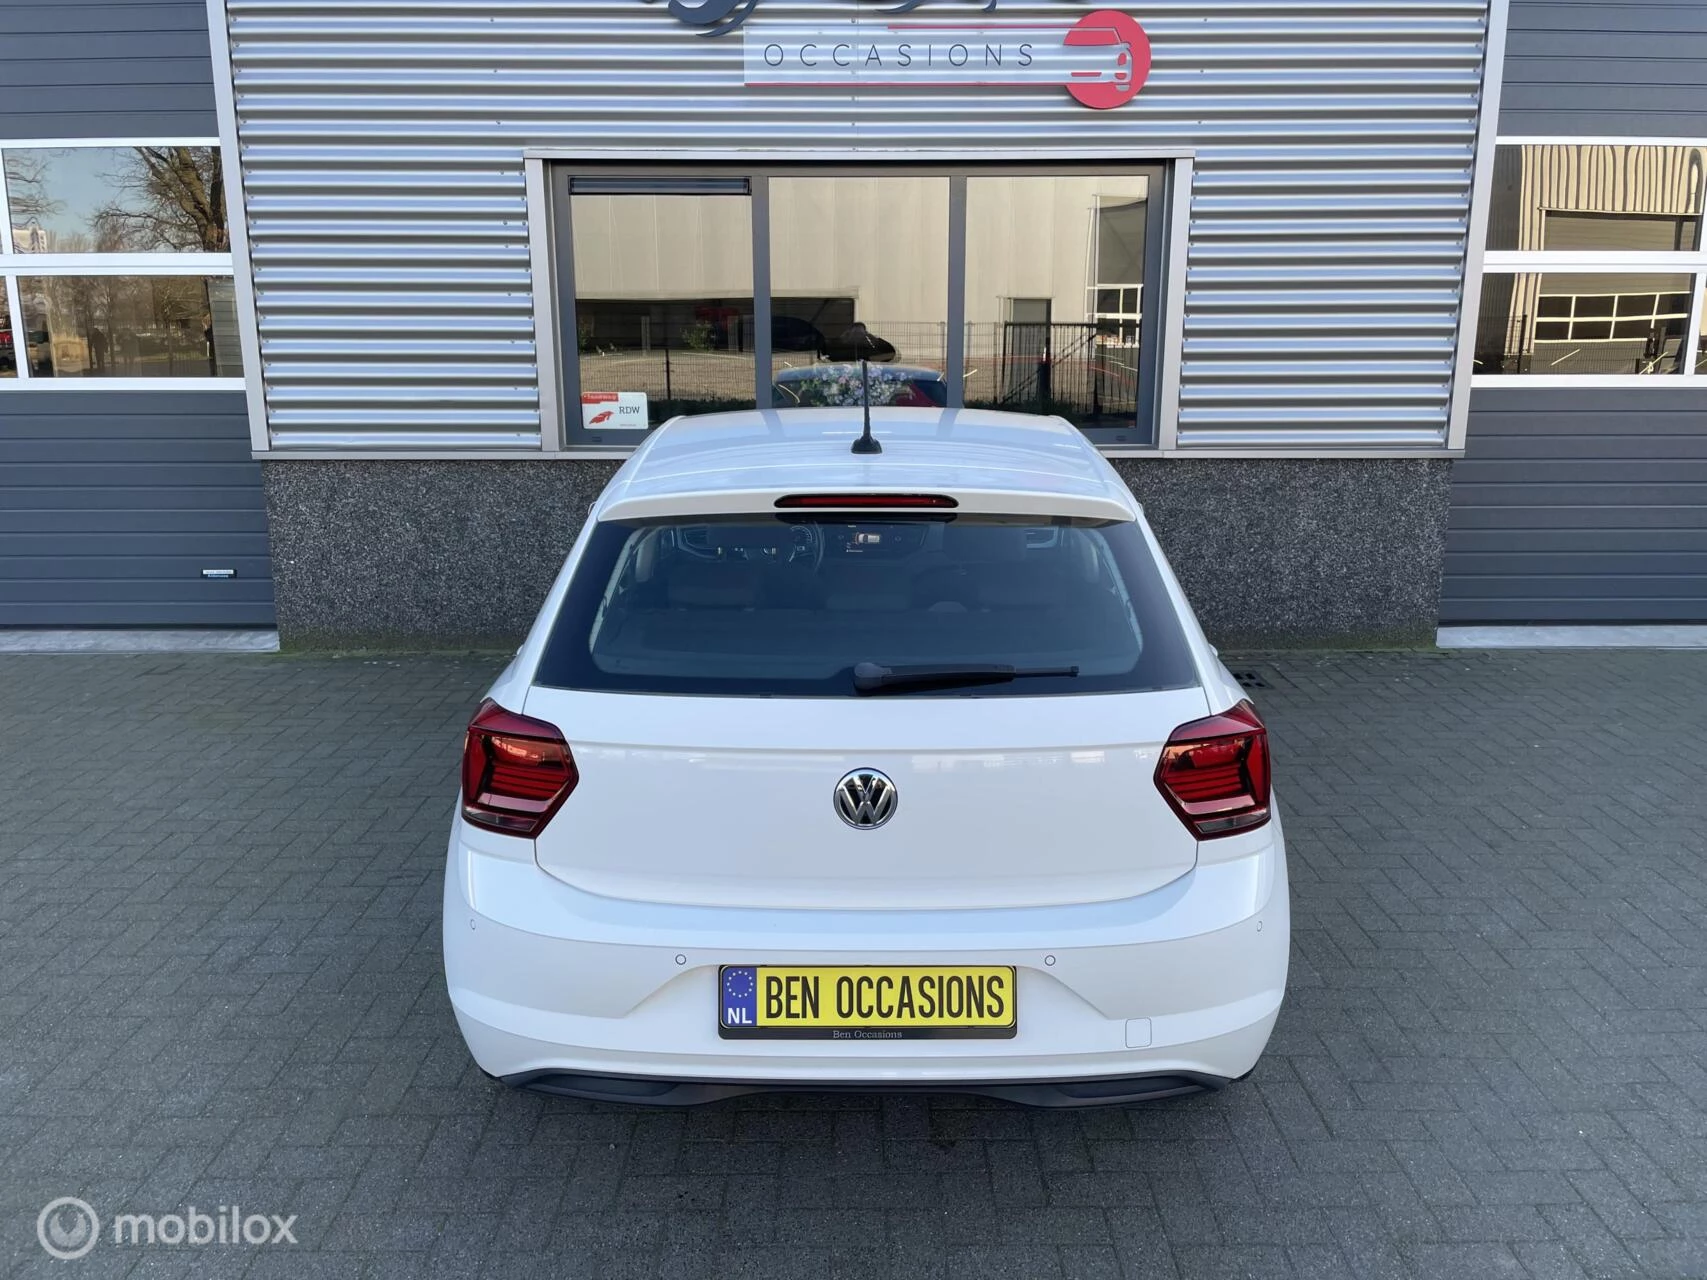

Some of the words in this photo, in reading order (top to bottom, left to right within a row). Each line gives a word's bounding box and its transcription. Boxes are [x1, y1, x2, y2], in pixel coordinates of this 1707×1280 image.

[764, 43, 1033, 67] OCCASIONS
[619, 406, 640, 415] RDW
[766, 975, 819, 1019] BEN
[836, 975, 1004, 1019] OCCASIONS
[727, 1007, 752, 1024] NL
[833, 1030, 851, 1039] Ben
[854, 1030, 903, 1039] Occasions
